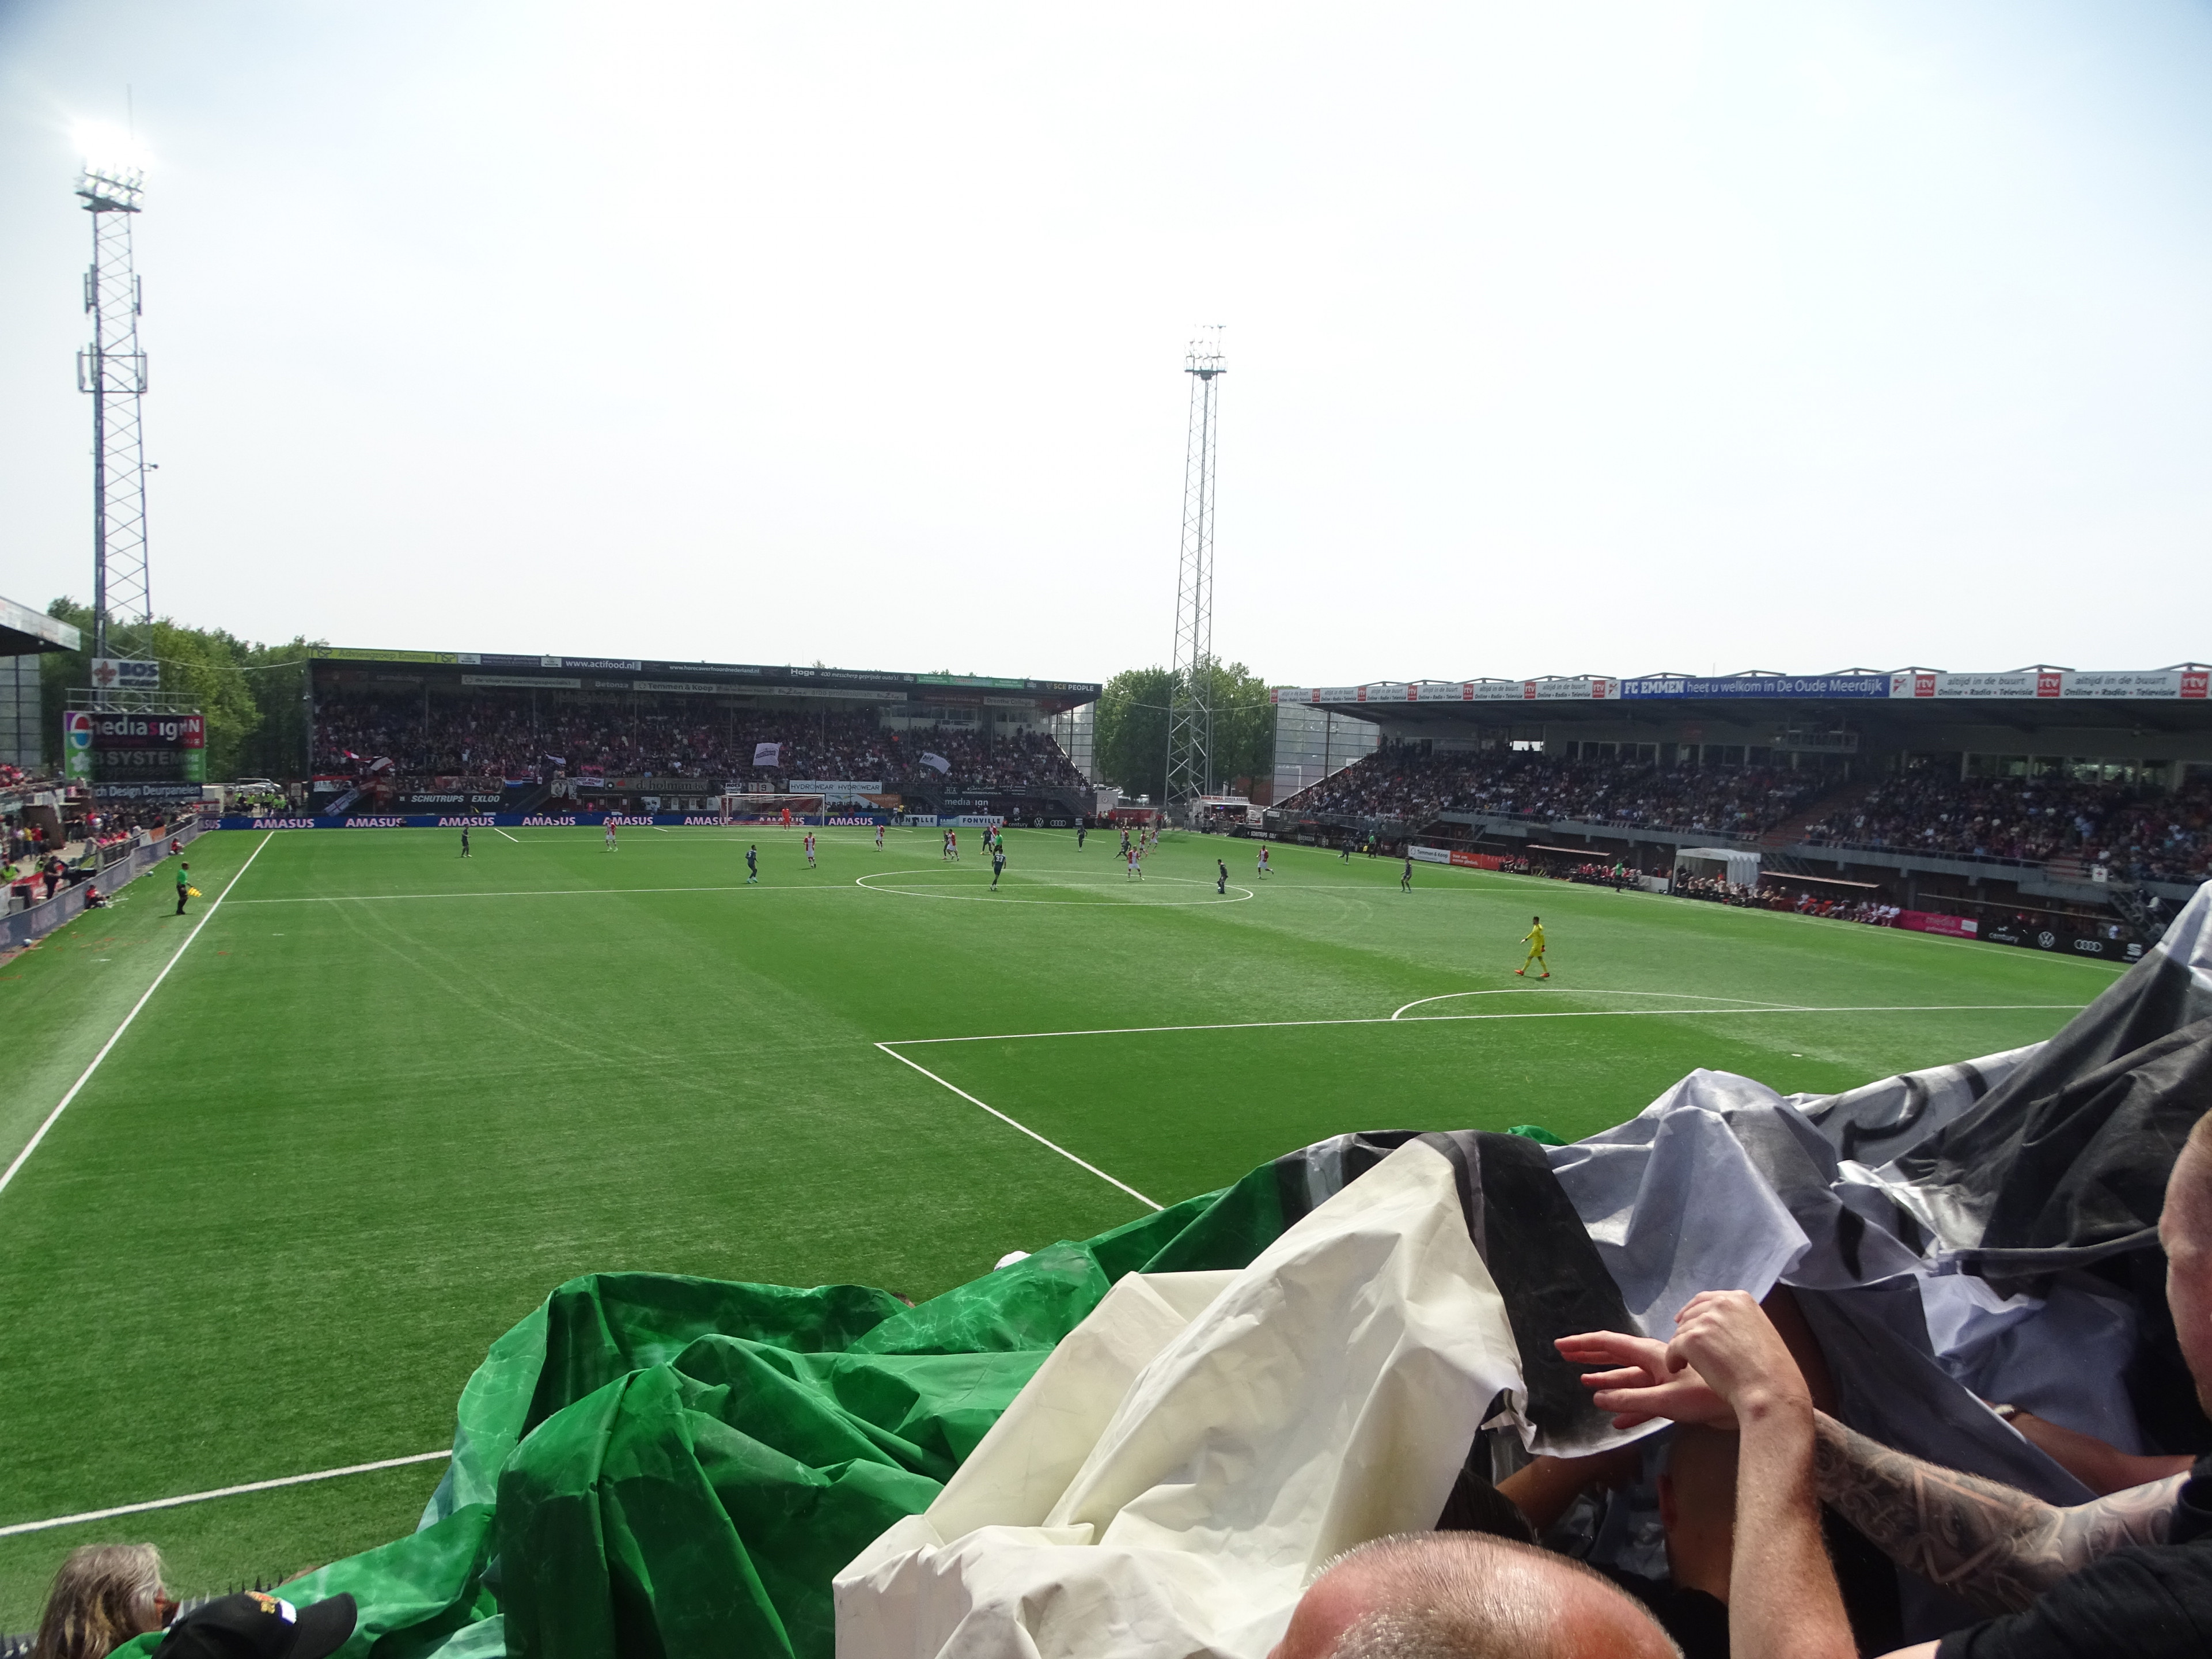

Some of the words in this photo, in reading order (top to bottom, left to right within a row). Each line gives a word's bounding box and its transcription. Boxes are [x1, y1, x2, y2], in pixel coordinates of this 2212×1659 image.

[566, 660, 634, 670] www.actifood.nl
[669, 665, 760, 673] www.horecawerfnoordnederland.nl
[790, 668, 815, 676] Hoge
[1916, 679, 1933, 688] rtv
[1947, 677, 1971, 686] altijd
[1972, 677, 1982, 685] in
[1984, 677, 1995, 685] de
[1999, 676, 2025, 685] buurt
[2039, 677, 2059, 688] rtv
[2181, 677, 2207, 687] rtv
[1624, 682, 1638, 694] FC
[1641, 680, 1684, 694] EMMEN
[1687, 681, 1709, 692] heet
[1711, 684, 1718, 692] u
[1721, 680, 1761, 692] welkom
[1763, 680, 1775, 692] in
[1777, 679, 1793, 692] De
[1794, 679, 1827, 692] Oude
[1830, 679, 1882, 695] Meerdijk
[650, 780, 692, 790] holman
[110, 786, 141, 798] Design
[253, 819, 315, 829] AMASUS
[346, 818, 403, 828] AMASUS
[439, 817, 495, 827] AMASUS
[522, 817, 576, 826] AMASUS
[603, 816, 653, 825] AMASUS
[828, 817, 873, 825] AMASUS
[1988, 931, 2018, 943] century
